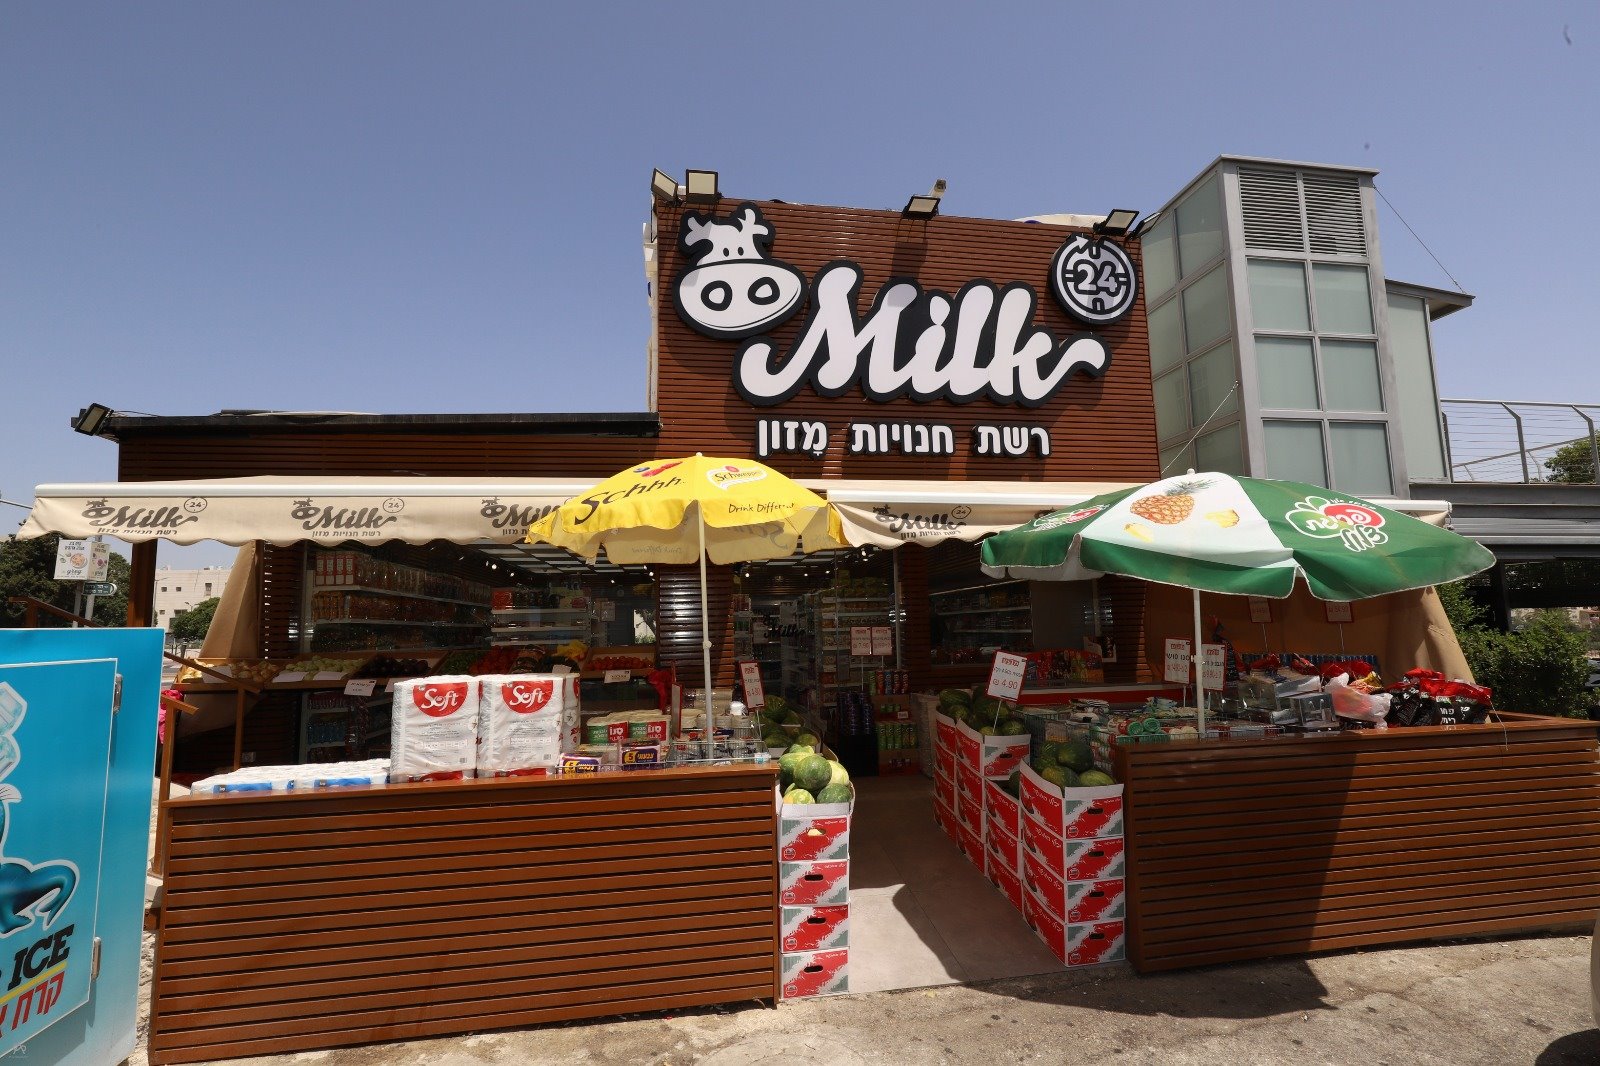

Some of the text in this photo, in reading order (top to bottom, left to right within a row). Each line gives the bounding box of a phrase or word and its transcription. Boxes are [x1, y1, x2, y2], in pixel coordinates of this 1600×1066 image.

[1076, 263, 1118, 293] 24
[740, 265, 1107, 401] Milk
[850, 422, 954, 454] חנויות
[977, 425, 1051, 456] רשת
[189, 500, 202, 508] 24
[387, 501, 400, 509] 24
[491, 503, 562, 528] Mil
[728, 501, 795, 514] Drink Different
[88, 505, 199, 529] Milk
[302, 505, 398, 531] Milk
[889, 512, 967, 533] Milk
[1001, 679, 1018, 690] 4.90
[420, 688, 459, 712] Soft
[509, 685, 546, 709] Soft
[628, 752, 634, 760] 5
[7, 923, 75, 992] ICE
[11, 970, 66, 1032] קרח
